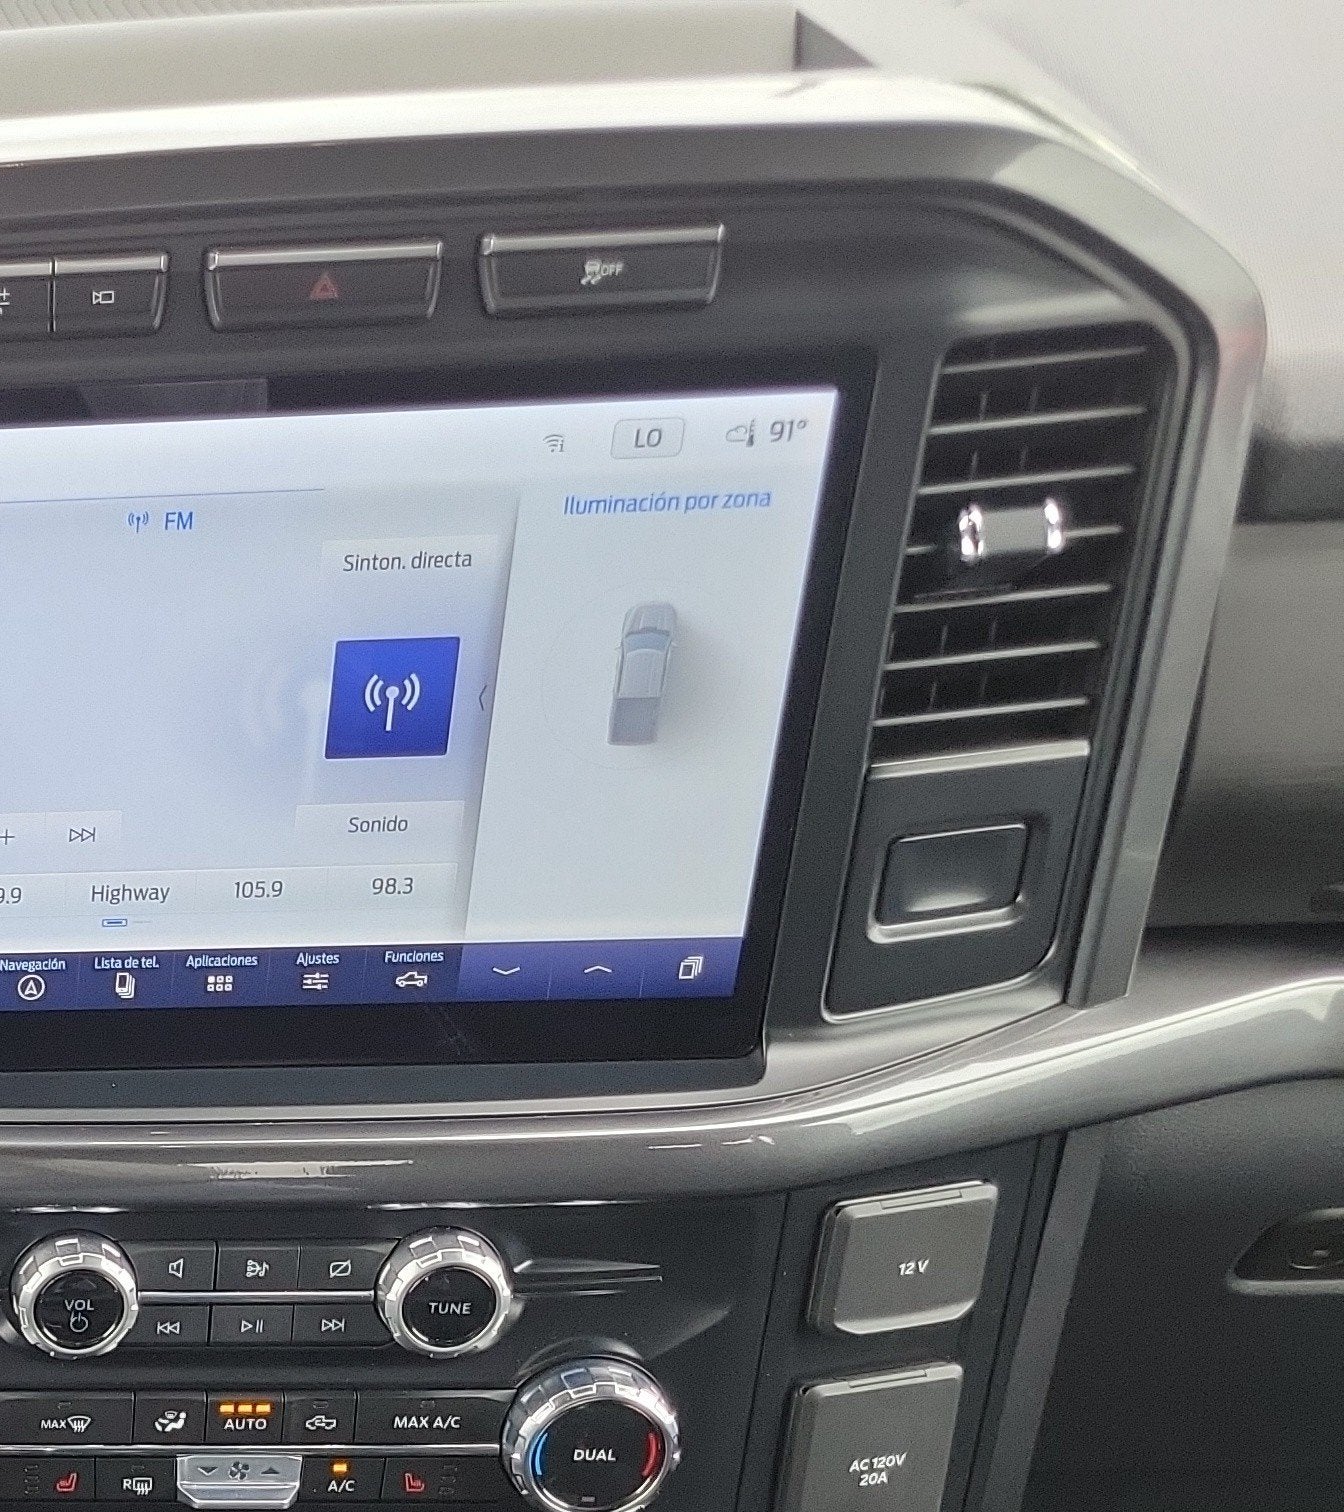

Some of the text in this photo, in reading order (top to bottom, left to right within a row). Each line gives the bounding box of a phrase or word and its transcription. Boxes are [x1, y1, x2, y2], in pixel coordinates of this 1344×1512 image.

[600, 262, 624, 277] OFF
[632, 427, 664, 449] LO
[562, 490, 773, 516] Iluminación por zona
[163, 511, 195, 532] FM
[342, 549, 474, 573] Sinton. directa
[347, 814, 410, 834] Sonido
[90, 882, 171, 906] Highway
[233, 879, 285, 900] 105.9
[371, 876, 415, 897] 98.3
[93, 955, 122, 971] Lista
[123, 956, 140, 971] de
[184, 953, 259, 970] Aplicaciones
[295, 950, 341, 968] Ajustes
[383, 948, 446, 965] Funciones
[63, 1299, 95, 1313] VOL
[428, 1301, 472, 1316] TUNE
[40, 1418, 68, 1431] MAX
[223, 1418, 268, 1431] AUTO
[393, 1414, 462, 1430] MAX A/C
[572, 1447, 618, 1463] DUAL
[849, 1451, 908, 1473] AC 120V
[326, 1478, 356, 1493] A/C
[859, 1471, 889, 1487] 20A
